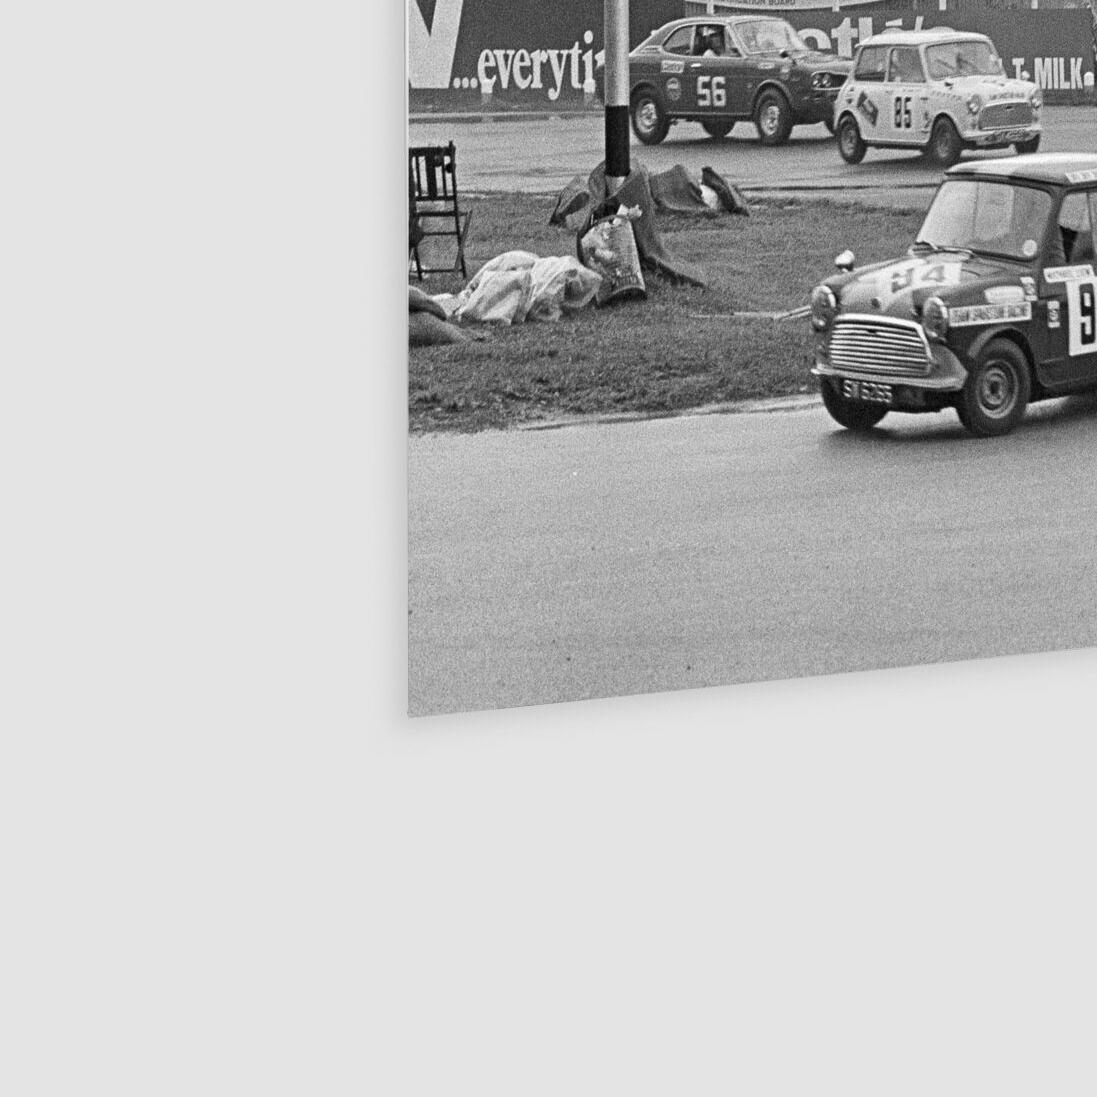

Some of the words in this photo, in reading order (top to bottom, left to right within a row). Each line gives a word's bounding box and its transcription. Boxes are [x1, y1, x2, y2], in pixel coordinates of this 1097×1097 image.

[453, 30, 605, 101] ...everyti
[1035, 57, 1083, 90] MILK
[697, 75, 727, 107] 56
